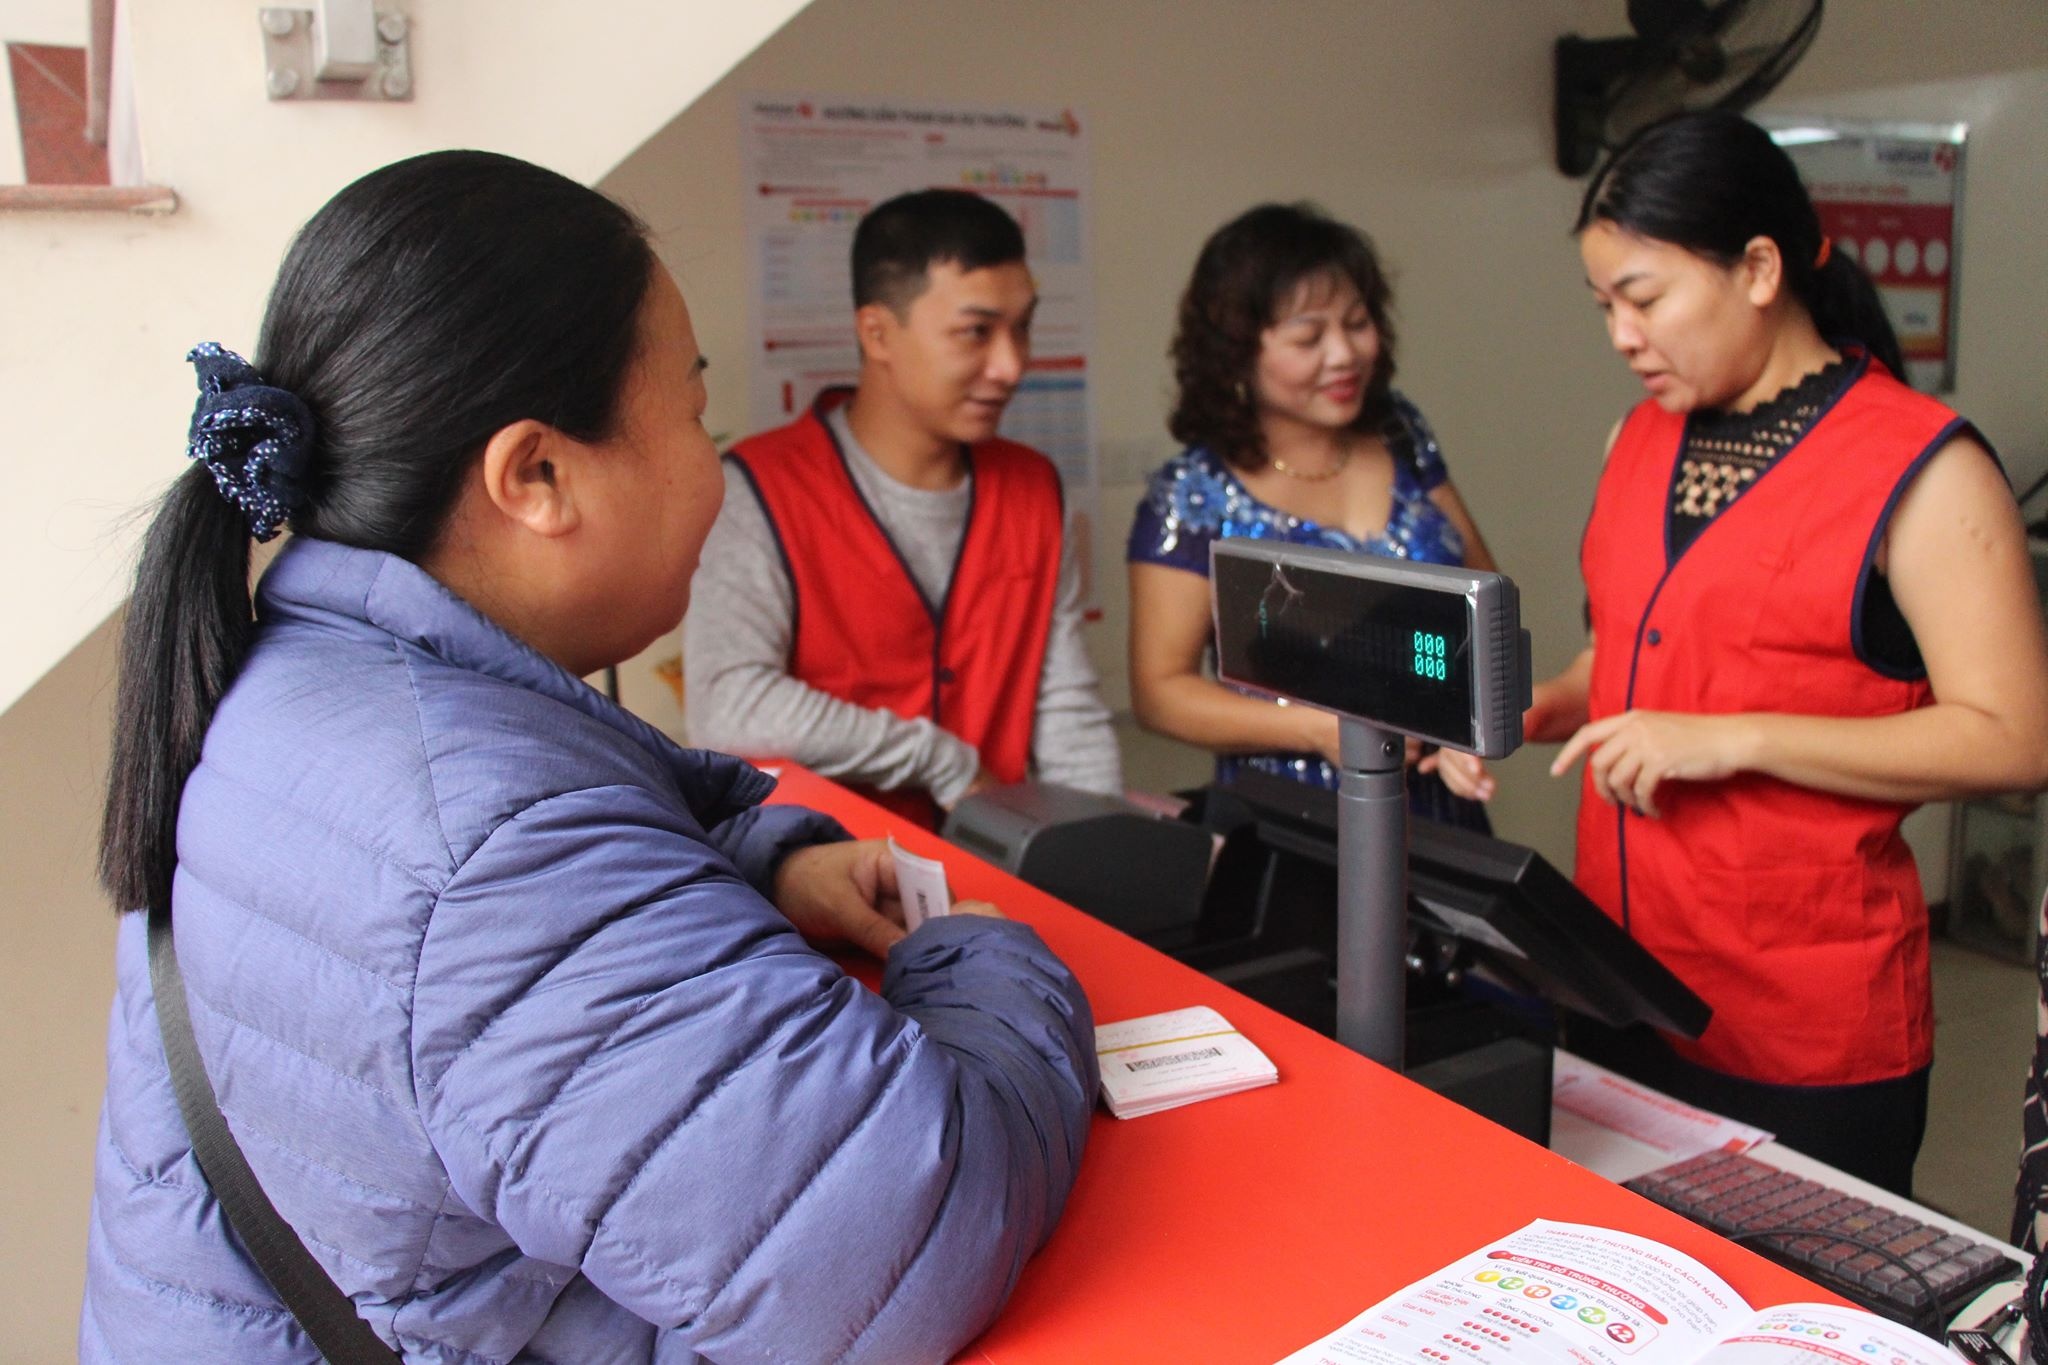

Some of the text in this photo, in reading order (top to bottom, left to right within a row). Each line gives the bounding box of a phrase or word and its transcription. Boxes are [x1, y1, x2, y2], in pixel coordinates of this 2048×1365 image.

[1414, 631, 1445, 657] 000
[1415, 654, 1445, 681] 000
[1533, 1260, 1553, 1270] TRA
[1551, 1264, 1567, 1275] SỐ
[1673, 1266, 1701, 1287] CÁCH
[1701, 1285, 1729, 1311] NÀO?
[1502, 1278, 1521, 1290] 12
[1606, 1325, 1634, 1343] 42
